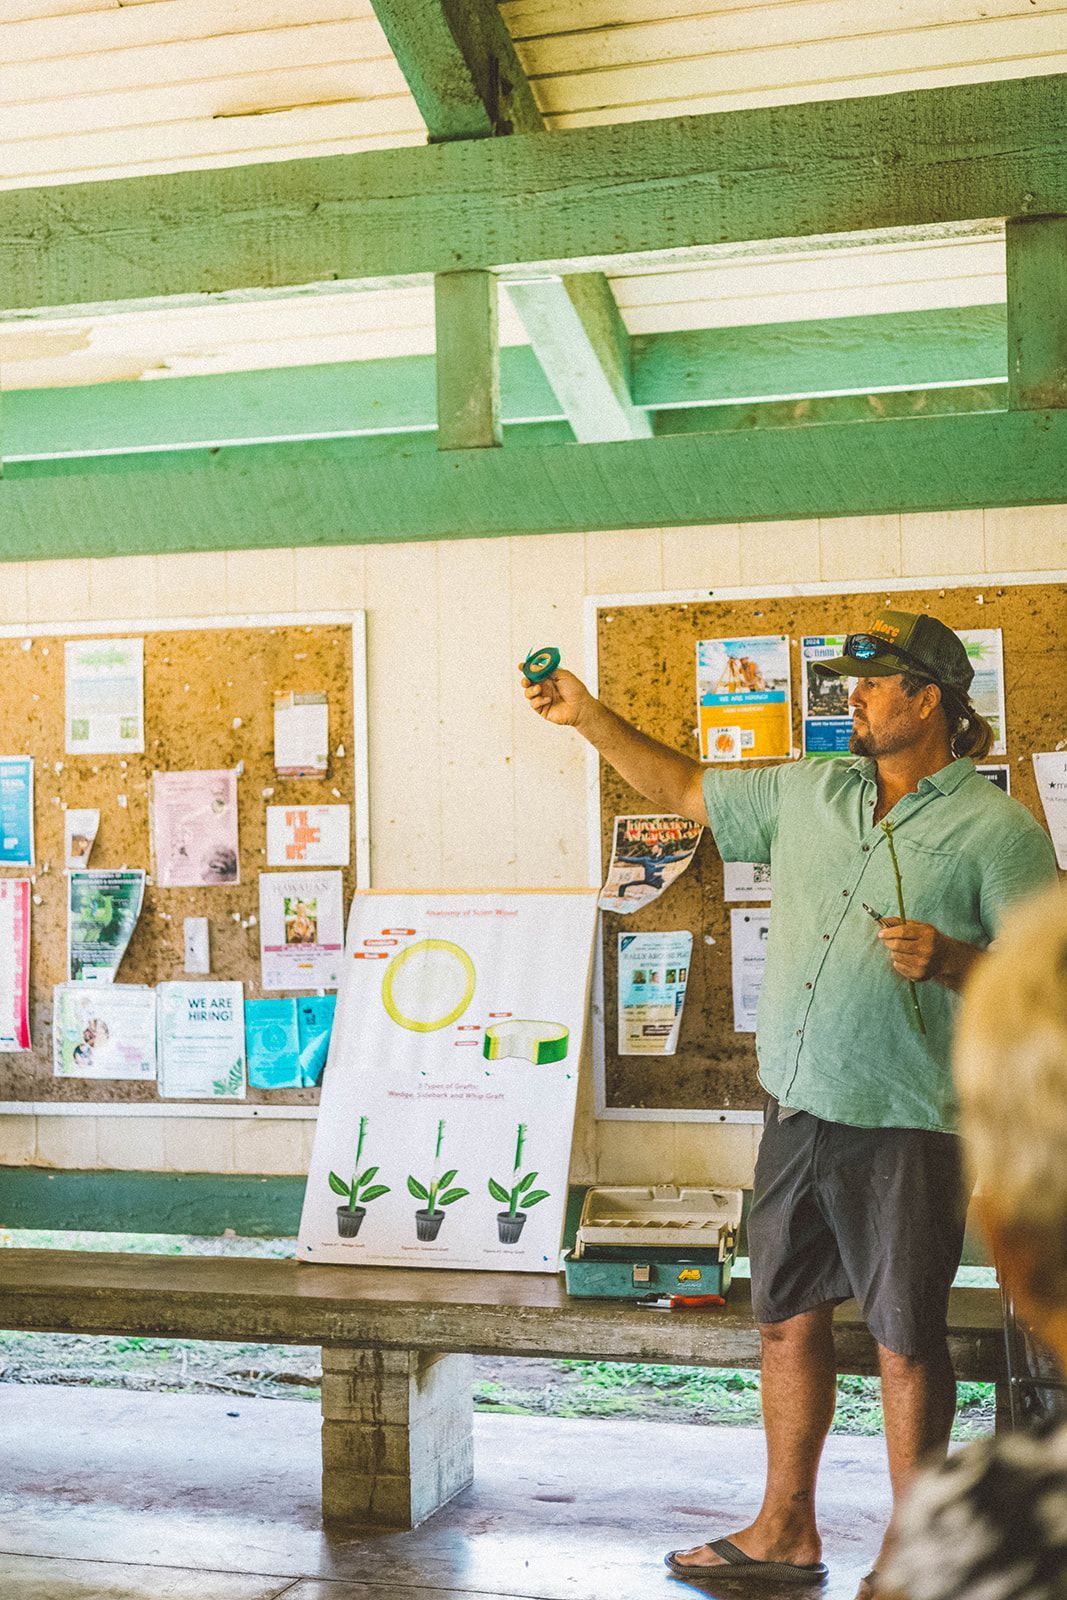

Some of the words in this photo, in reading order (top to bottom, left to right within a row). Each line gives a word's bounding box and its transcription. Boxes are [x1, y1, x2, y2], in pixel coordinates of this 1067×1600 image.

[871, 619, 899, 637] More
[187, 998, 206, 1008] WE
[210, 997, 233, 1008] ARE
[188, 1011, 233, 1021] HIRING!
